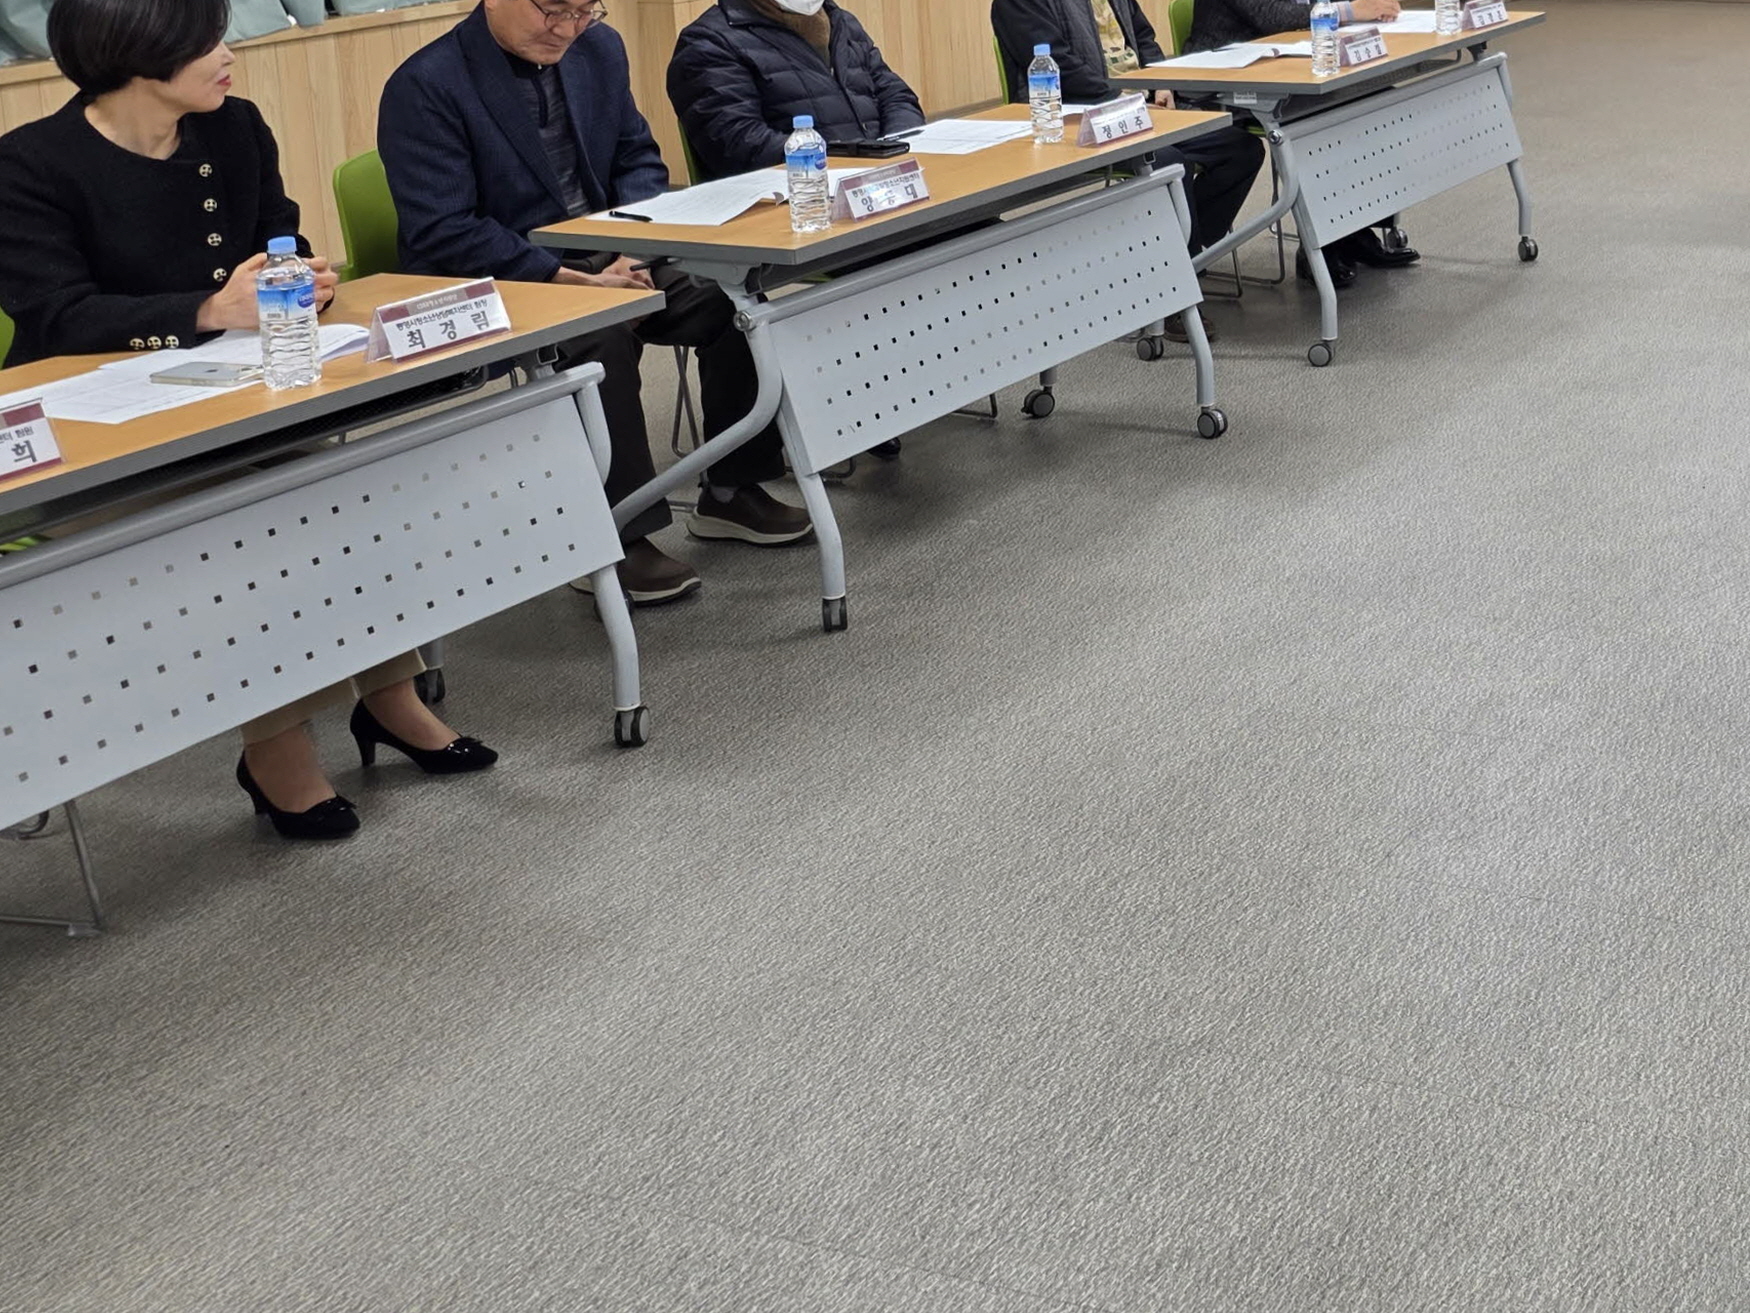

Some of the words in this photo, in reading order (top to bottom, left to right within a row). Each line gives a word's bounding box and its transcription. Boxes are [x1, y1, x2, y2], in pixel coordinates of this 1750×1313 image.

[406, 328, 427, 349] 최
[439, 319, 458, 340] 경
[470, 310, 490, 331] 림
